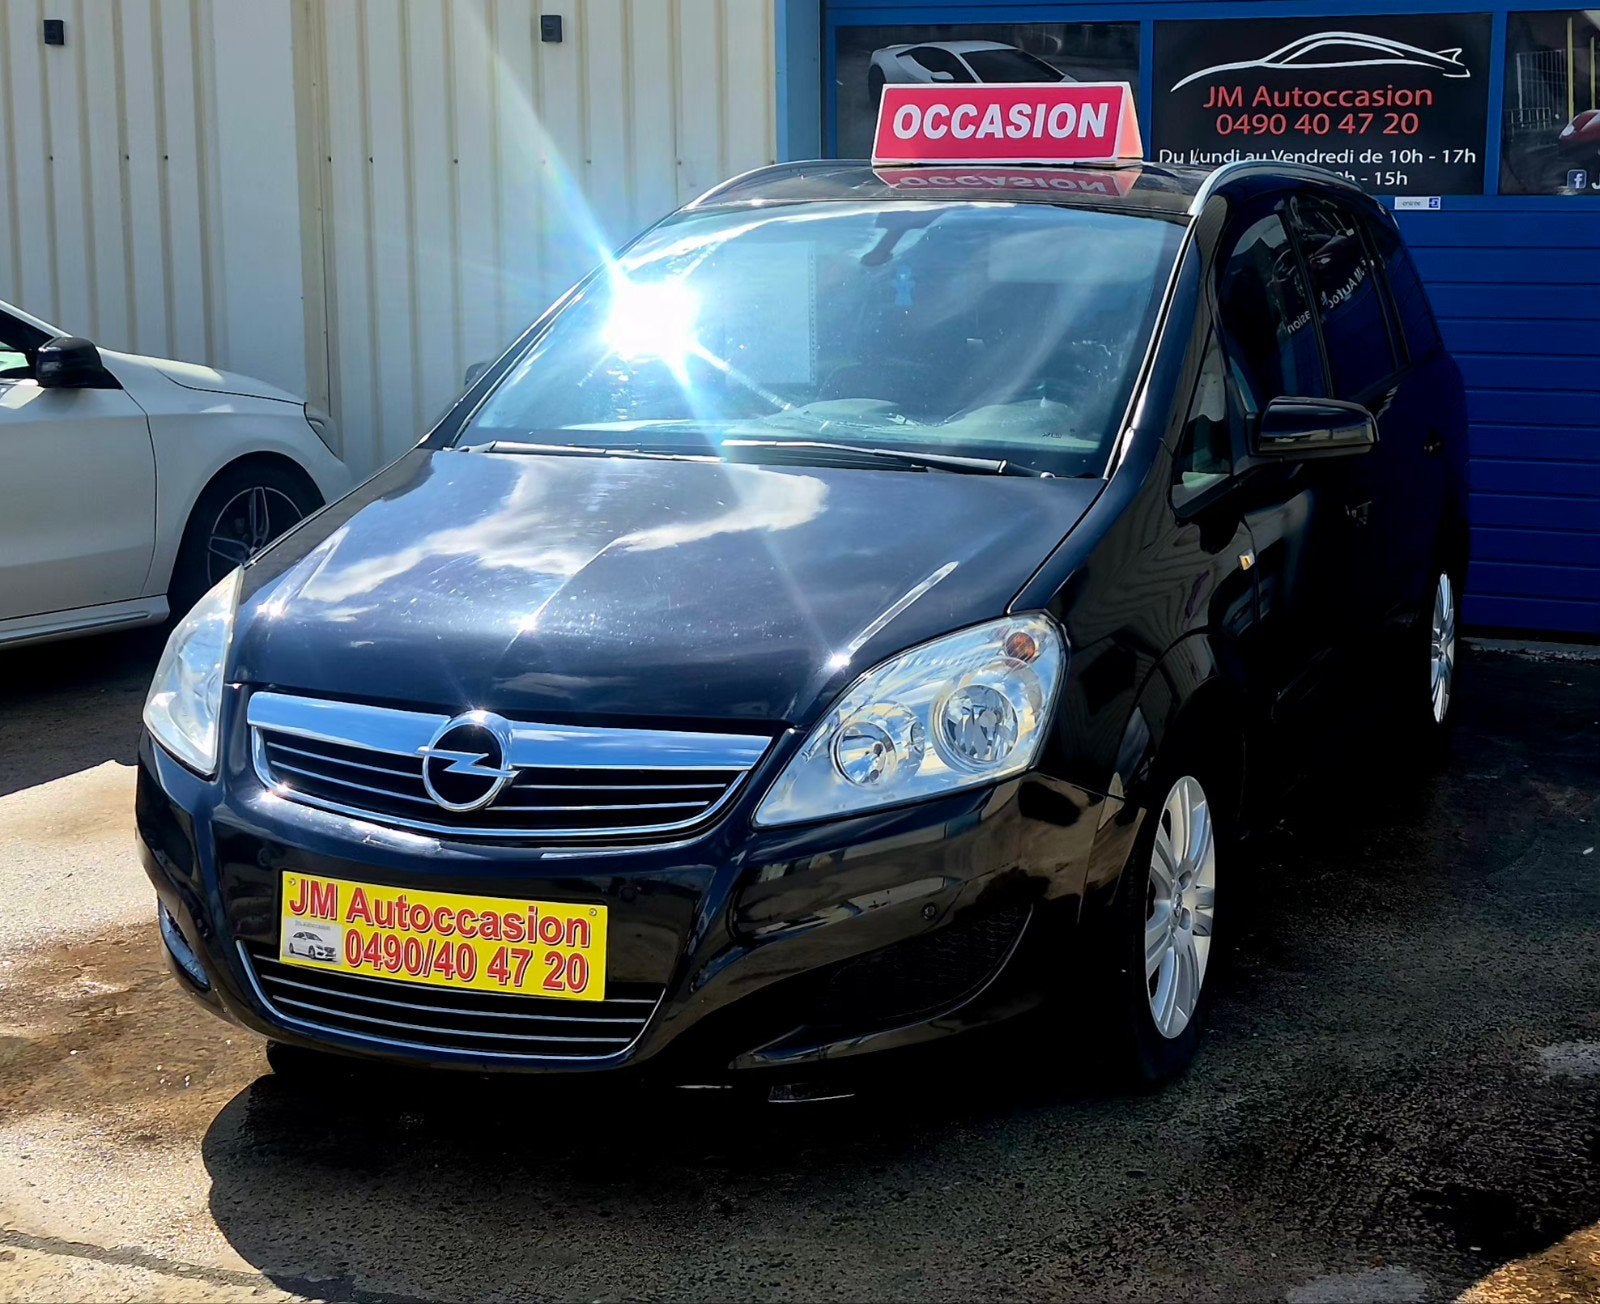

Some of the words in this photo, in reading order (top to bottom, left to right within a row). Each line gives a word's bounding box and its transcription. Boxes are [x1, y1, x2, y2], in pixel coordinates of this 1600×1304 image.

[1202, 85, 1243, 108] JM
[1252, 84, 1433, 107] Autoccasion
[892, 102, 1109, 140] OCCASION
[1215, 113, 1287, 135] 0490
[1293, 113, 1330, 135] 40
[1337, 113, 1374, 134] 47
[1382, 112, 1419, 134] 20
[1159, 149, 1184, 163] Du
[1245, 152, 1267, 161] au
[1271, 149, 1354, 163] Vendredi
[1359, 149, 1383, 163] de
[1390, 149, 1423, 163] 10h
[1443, 149, 1476, 163] 17h
[1374, 171, 1408, 186] 15h
[289, 878, 338, 921] JM
[345, 887, 590, 949] Autoccasion
[344, 929, 477, 982] 0490/40
[487, 944, 533, 987] 47
[543, 951, 589, 993] 20
